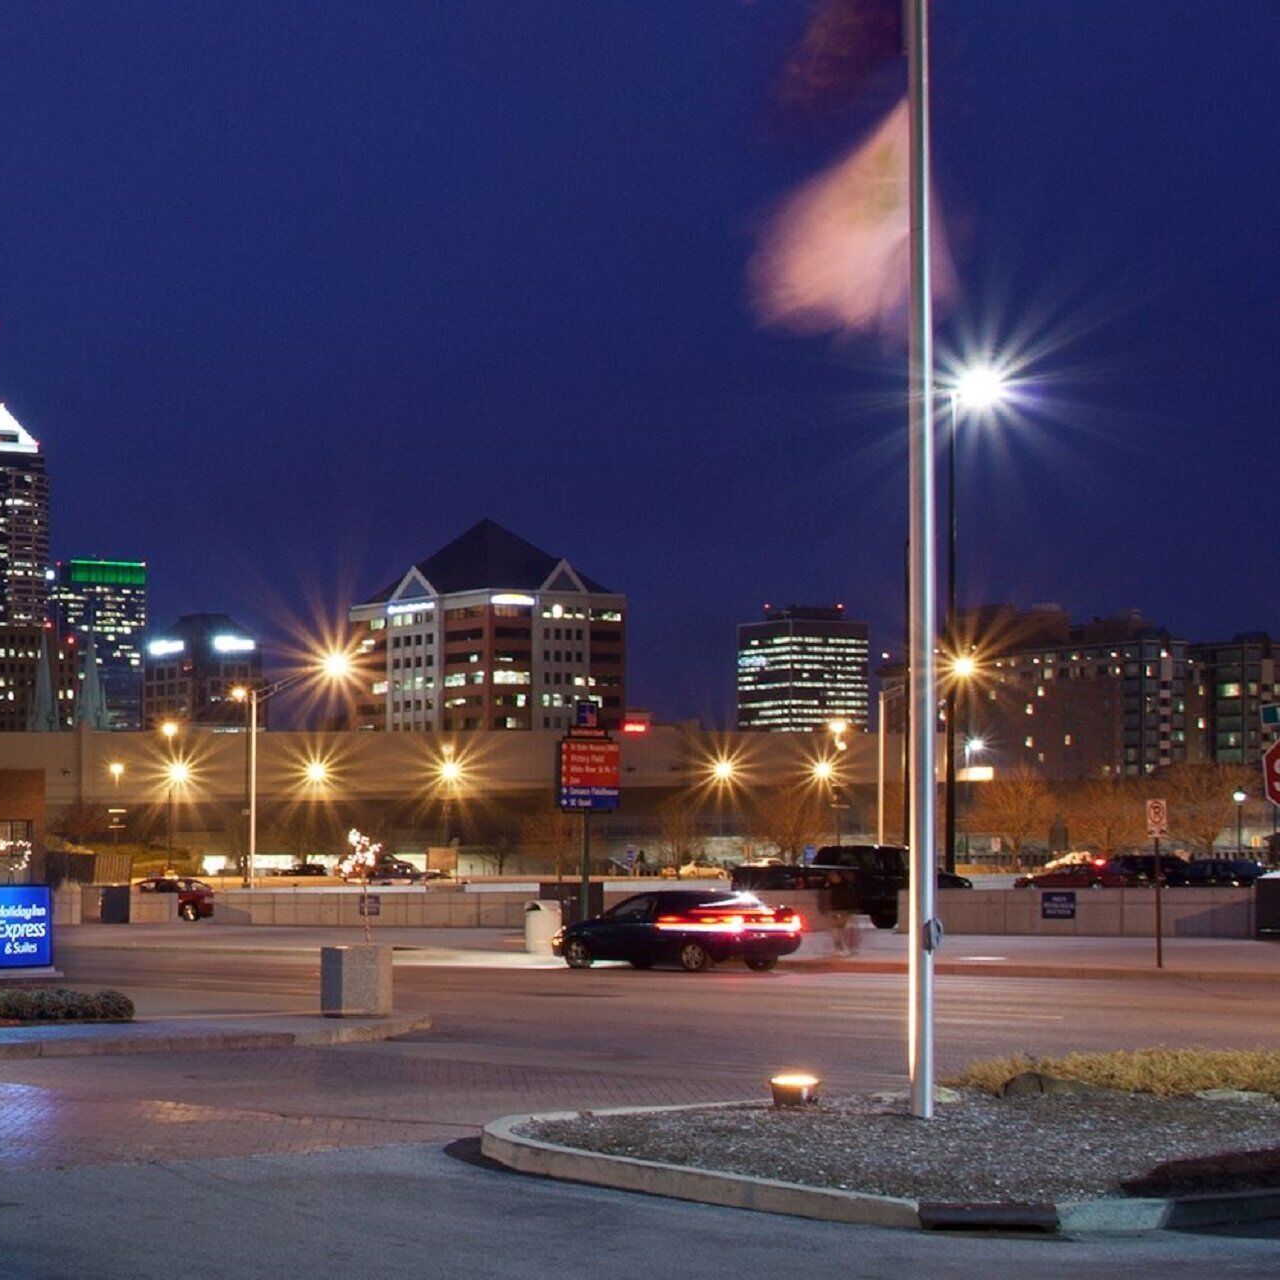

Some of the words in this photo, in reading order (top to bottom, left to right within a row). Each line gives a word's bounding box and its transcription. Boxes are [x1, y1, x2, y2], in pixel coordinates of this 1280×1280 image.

[31, 904, 46, 917] Inn
[4, 942, 13, 955] &
[13, 942, 38, 955] Suites
